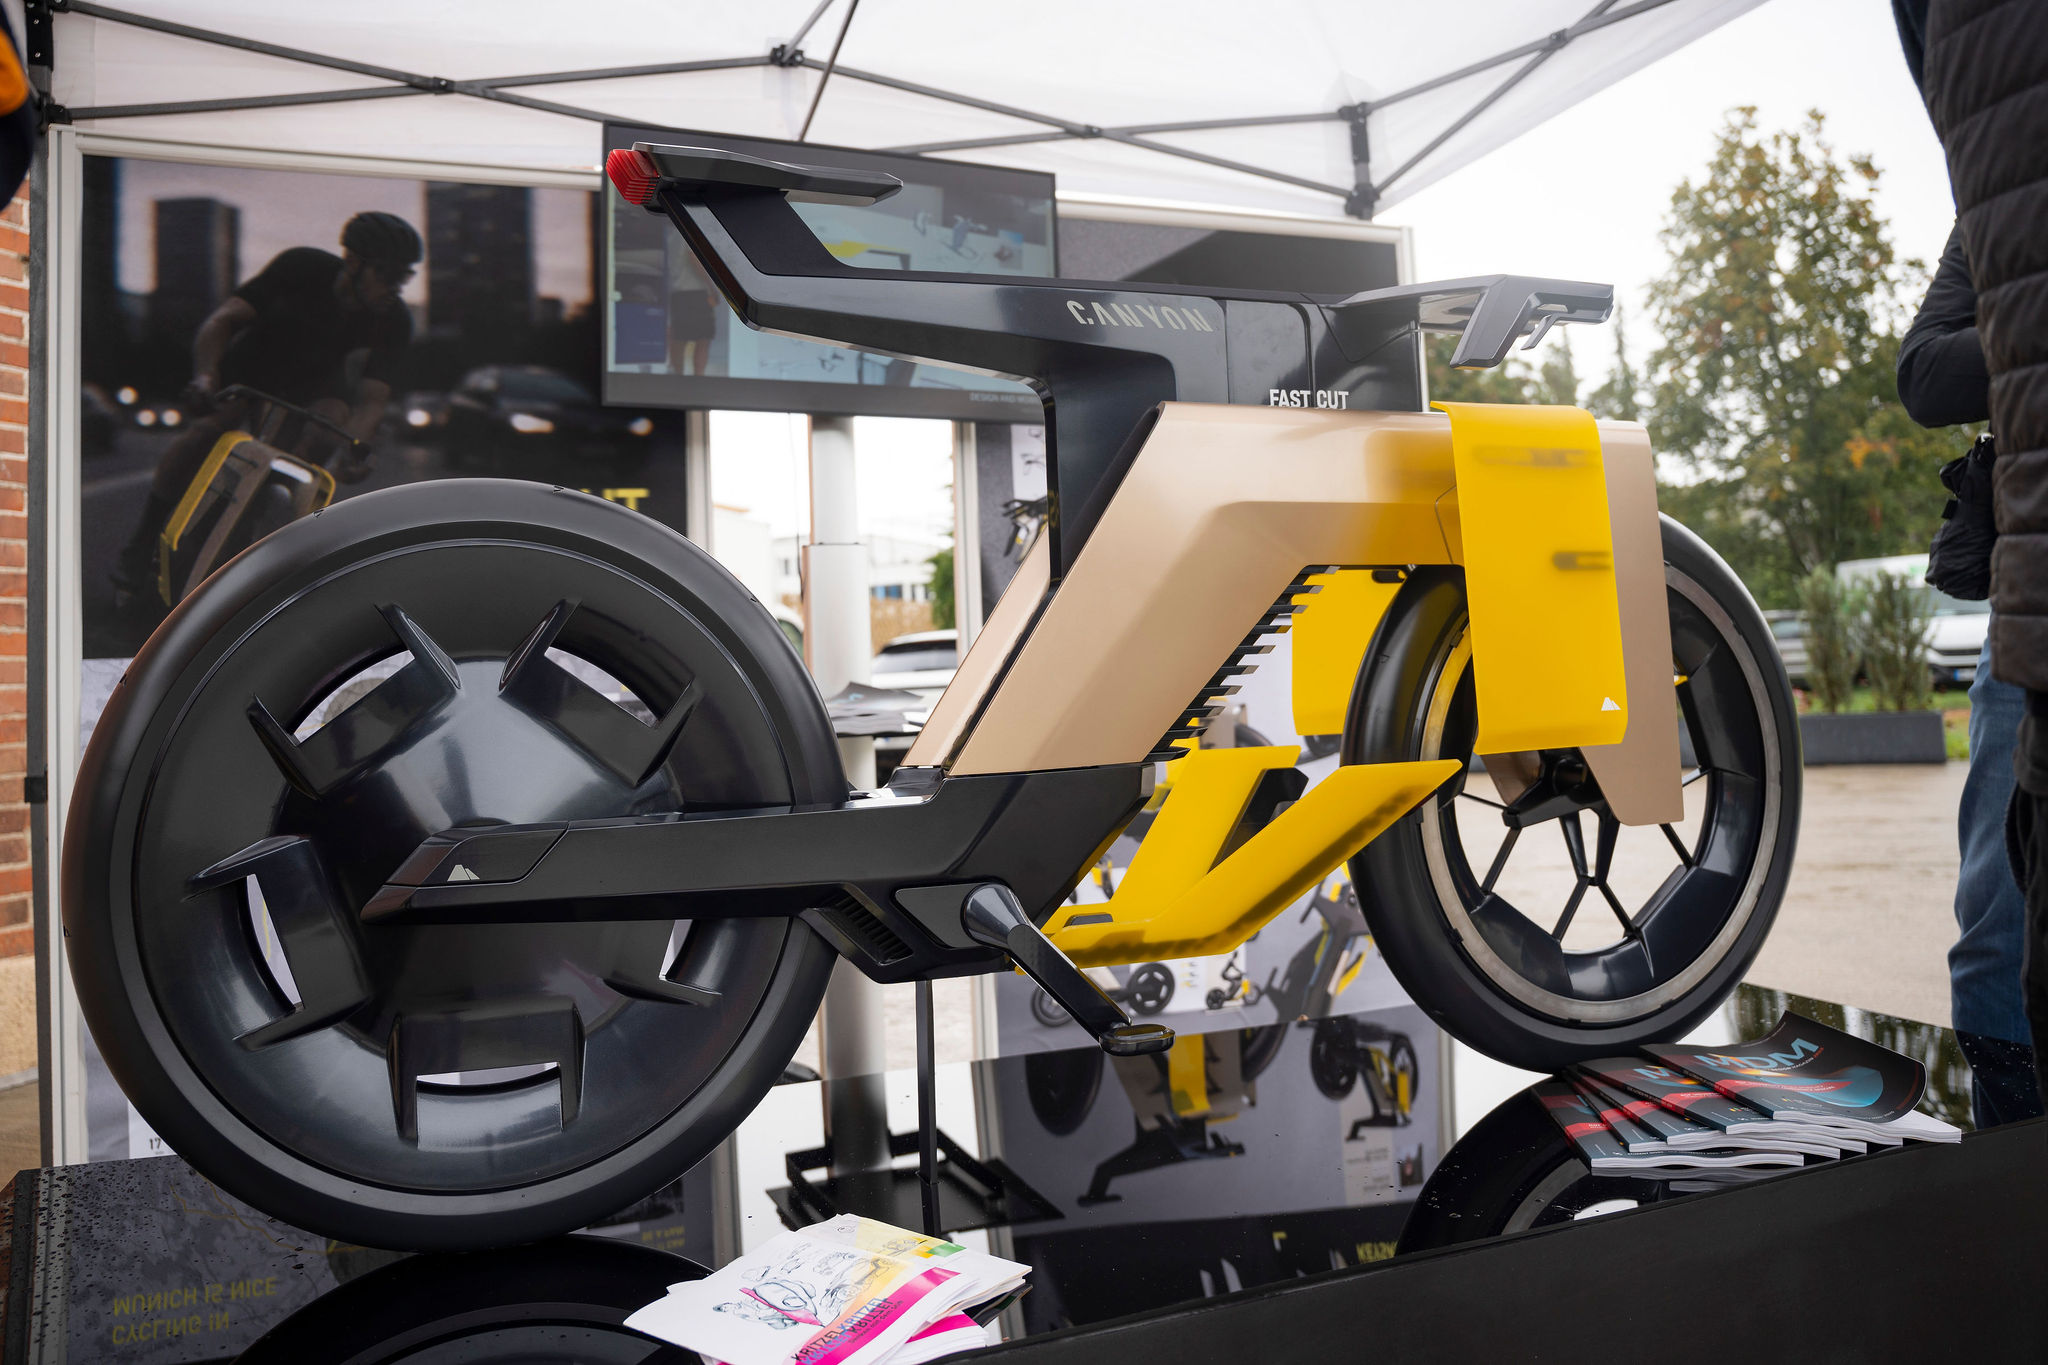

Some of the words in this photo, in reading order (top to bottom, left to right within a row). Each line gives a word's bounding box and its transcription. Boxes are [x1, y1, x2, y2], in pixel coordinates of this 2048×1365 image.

[1066, 300, 1213, 332] CANYON
[1269, 388, 1311, 408] FAST
[1316, 390, 1349, 410] CUT
[1694, 1038, 1819, 1069] MDM
